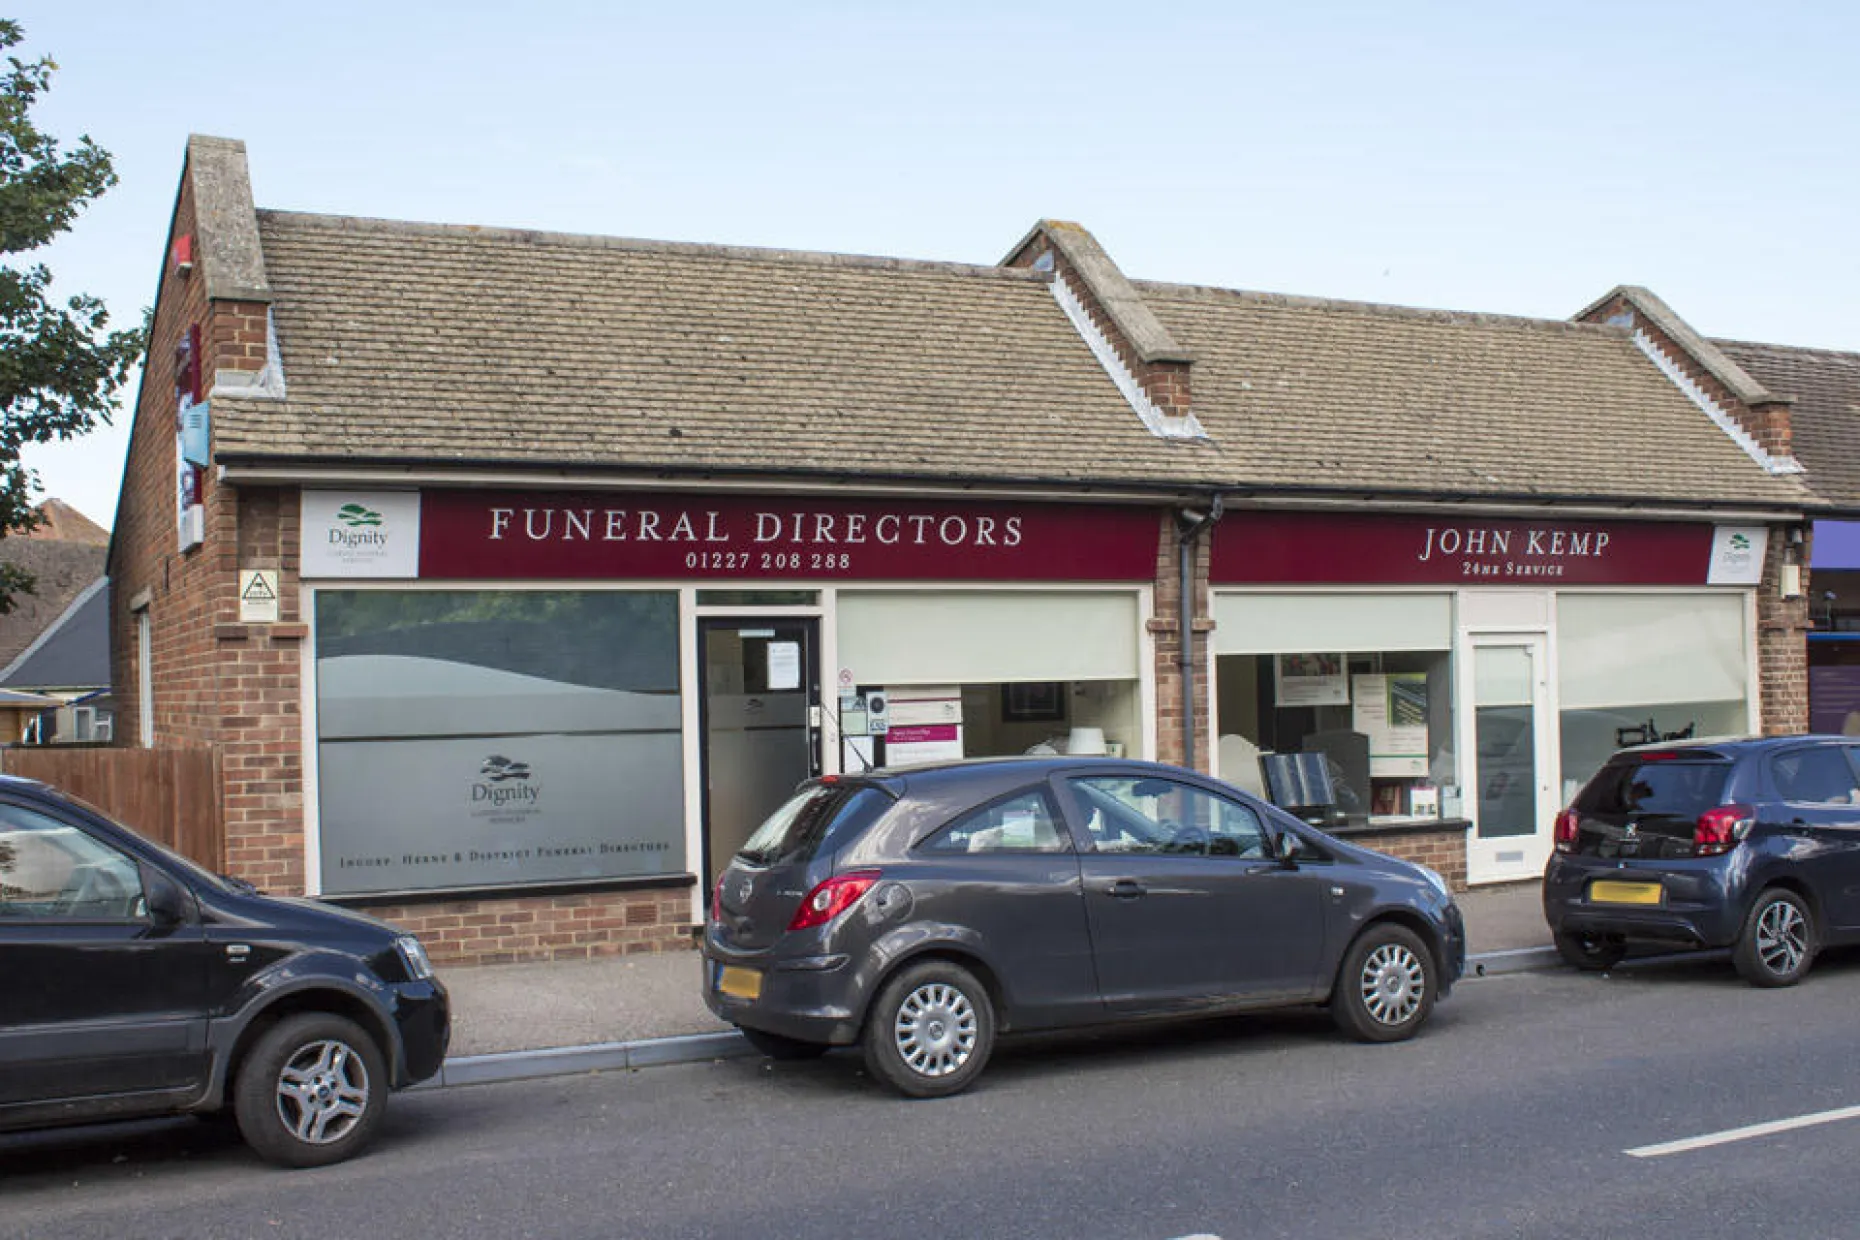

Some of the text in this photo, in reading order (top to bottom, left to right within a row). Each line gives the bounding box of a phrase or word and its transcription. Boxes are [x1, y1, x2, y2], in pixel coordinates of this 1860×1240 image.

[328, 528, 388, 549] Dignity
[488, 507, 1023, 546] FUNERAL DIRECTORS
[1418, 527, 1611, 561] JOHN KEMP
[685, 551, 851, 570] 01227 208 288
[472, 783, 540, 807] Dignity
